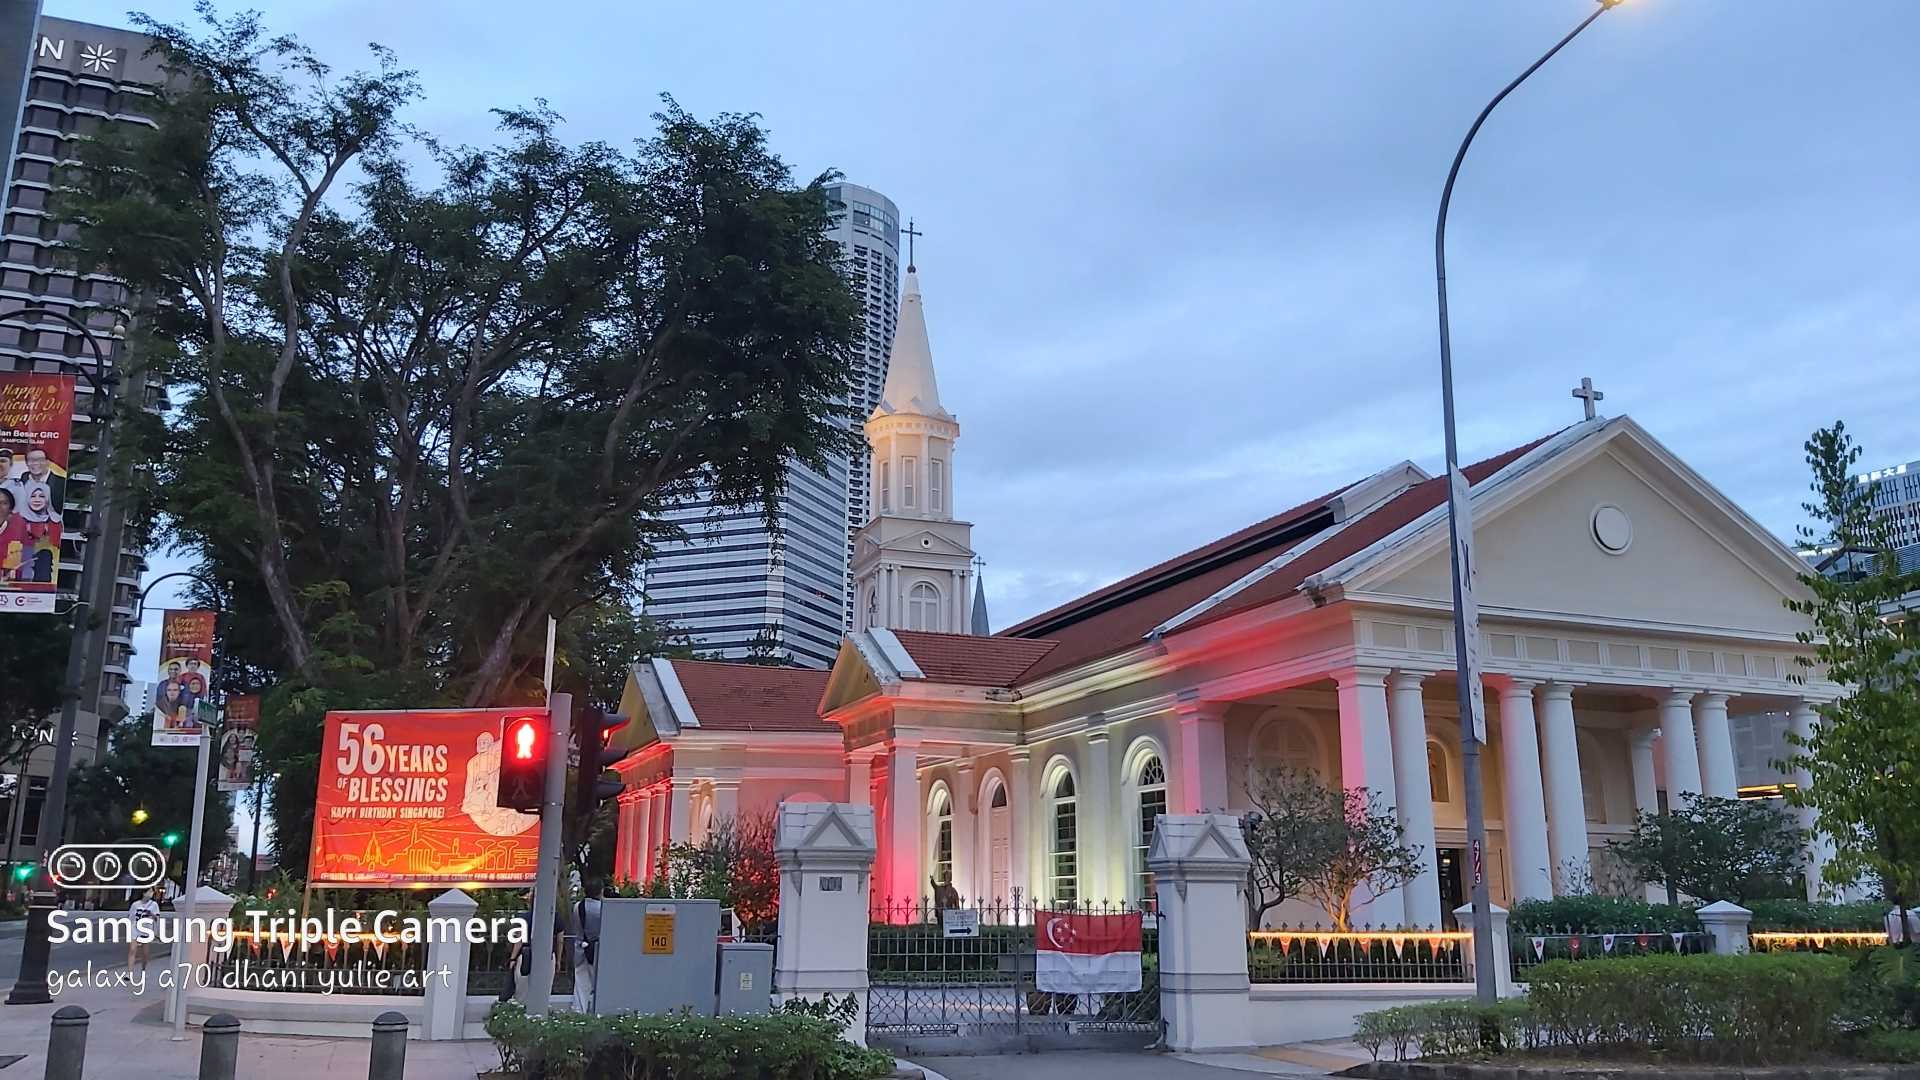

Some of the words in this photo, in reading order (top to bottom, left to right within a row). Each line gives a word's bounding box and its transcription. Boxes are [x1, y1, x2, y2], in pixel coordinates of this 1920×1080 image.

[2, 384, 44, 400] Happy
[13, 430, 39, 438] Besar
[40, 431, 60, 439] GRC
[337, 722, 385, 775] 56
[385, 744, 448, 773] YEARS
[337, 777, 348, 789] OF
[347, 776, 449, 803] BLESSINGS
[331, 806, 357, 819] HAPPY
[360, 806, 398, 819] BIRTHDAY
[651, 936, 667, 947] 140
